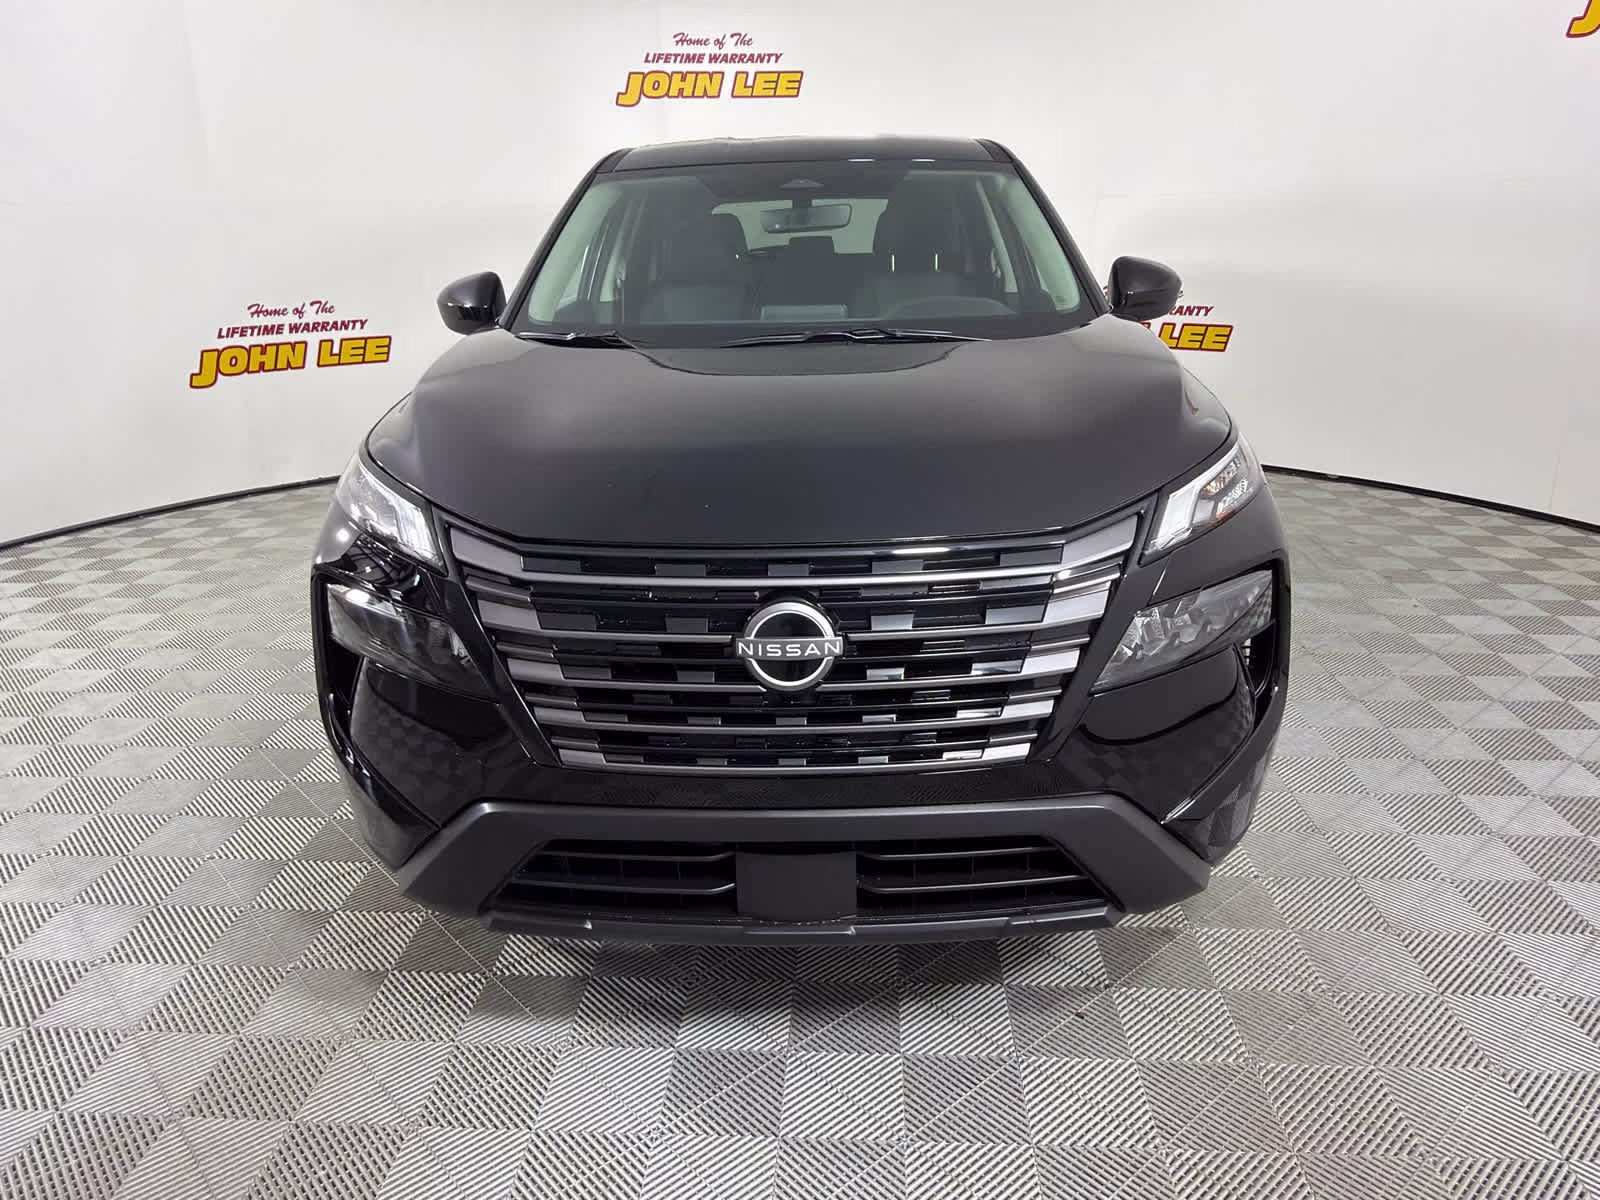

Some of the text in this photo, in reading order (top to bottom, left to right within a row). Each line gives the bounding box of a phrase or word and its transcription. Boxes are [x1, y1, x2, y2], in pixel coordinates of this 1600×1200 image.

[673, 32, 753, 49] Home of The
[644, 53, 782, 63] LIFETIME WARRANTY
[616, 71, 803, 107] JOHN LEE
[247, 300, 335, 319] Home of The
[217, 319, 367, 339] LIFETIME WARRANTY
[1158, 322, 1233, 352] LEE
[190, 336, 391, 389] JOHN LEE
[738, 642, 840, 656] NISSAN
